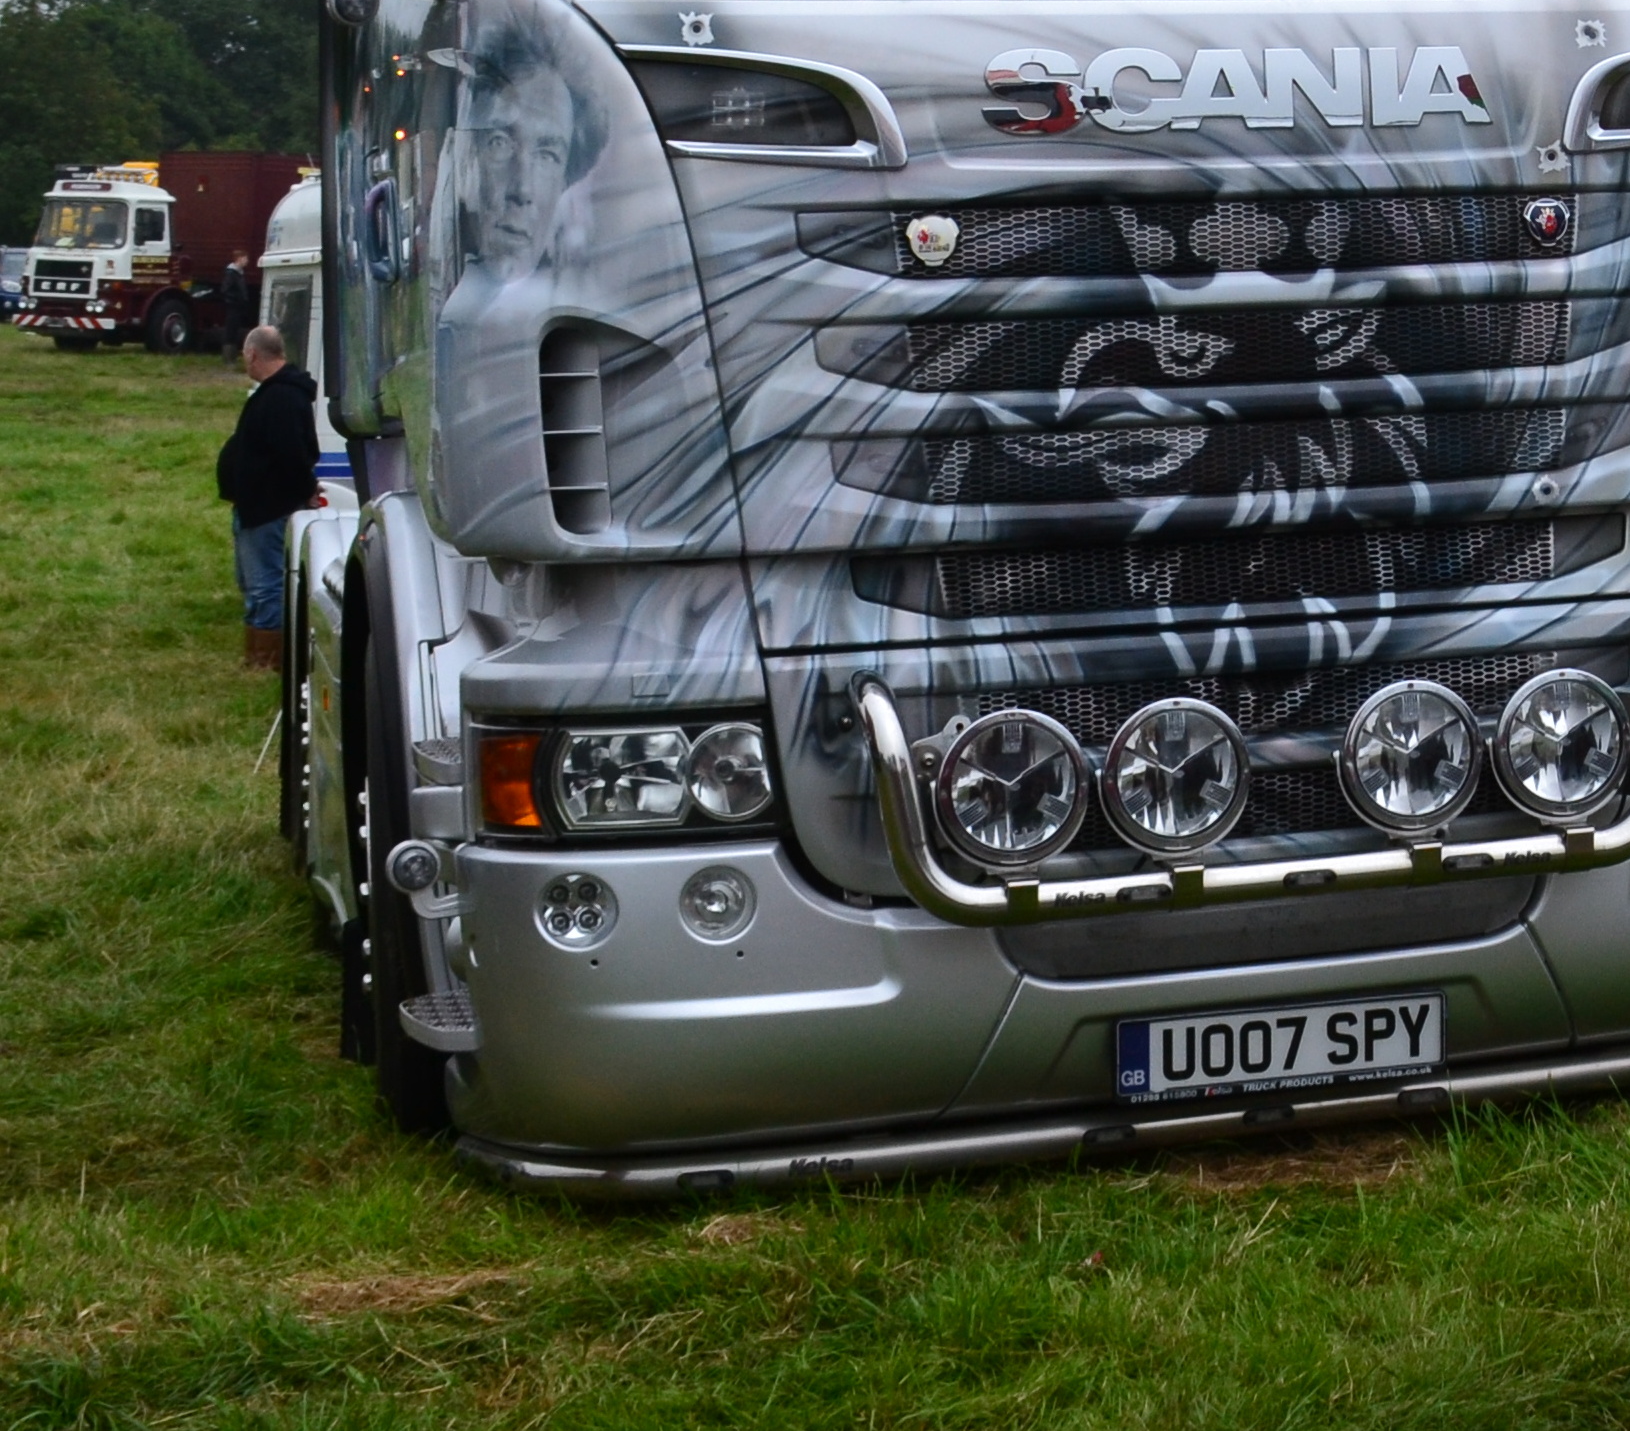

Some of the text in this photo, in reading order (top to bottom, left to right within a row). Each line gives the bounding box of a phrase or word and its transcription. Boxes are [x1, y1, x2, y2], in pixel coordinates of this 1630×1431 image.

[981, 46, 1493, 136] SCANIA
[41, 281, 81, 291] ERF
[1504, 849, 1553, 864] Kelsa
[1055, 891, 1107, 907] Kelsa
[1326, 1004, 1430, 1065] SPY
[1120, 1069, 1146, 1088] GB
[1242, 1079, 1277, 1093] TRUCK
[1279, 1074, 1334, 1090] PRODUCTS
[1349, 1066, 1432, 1082] www.kelsa.co.uk
